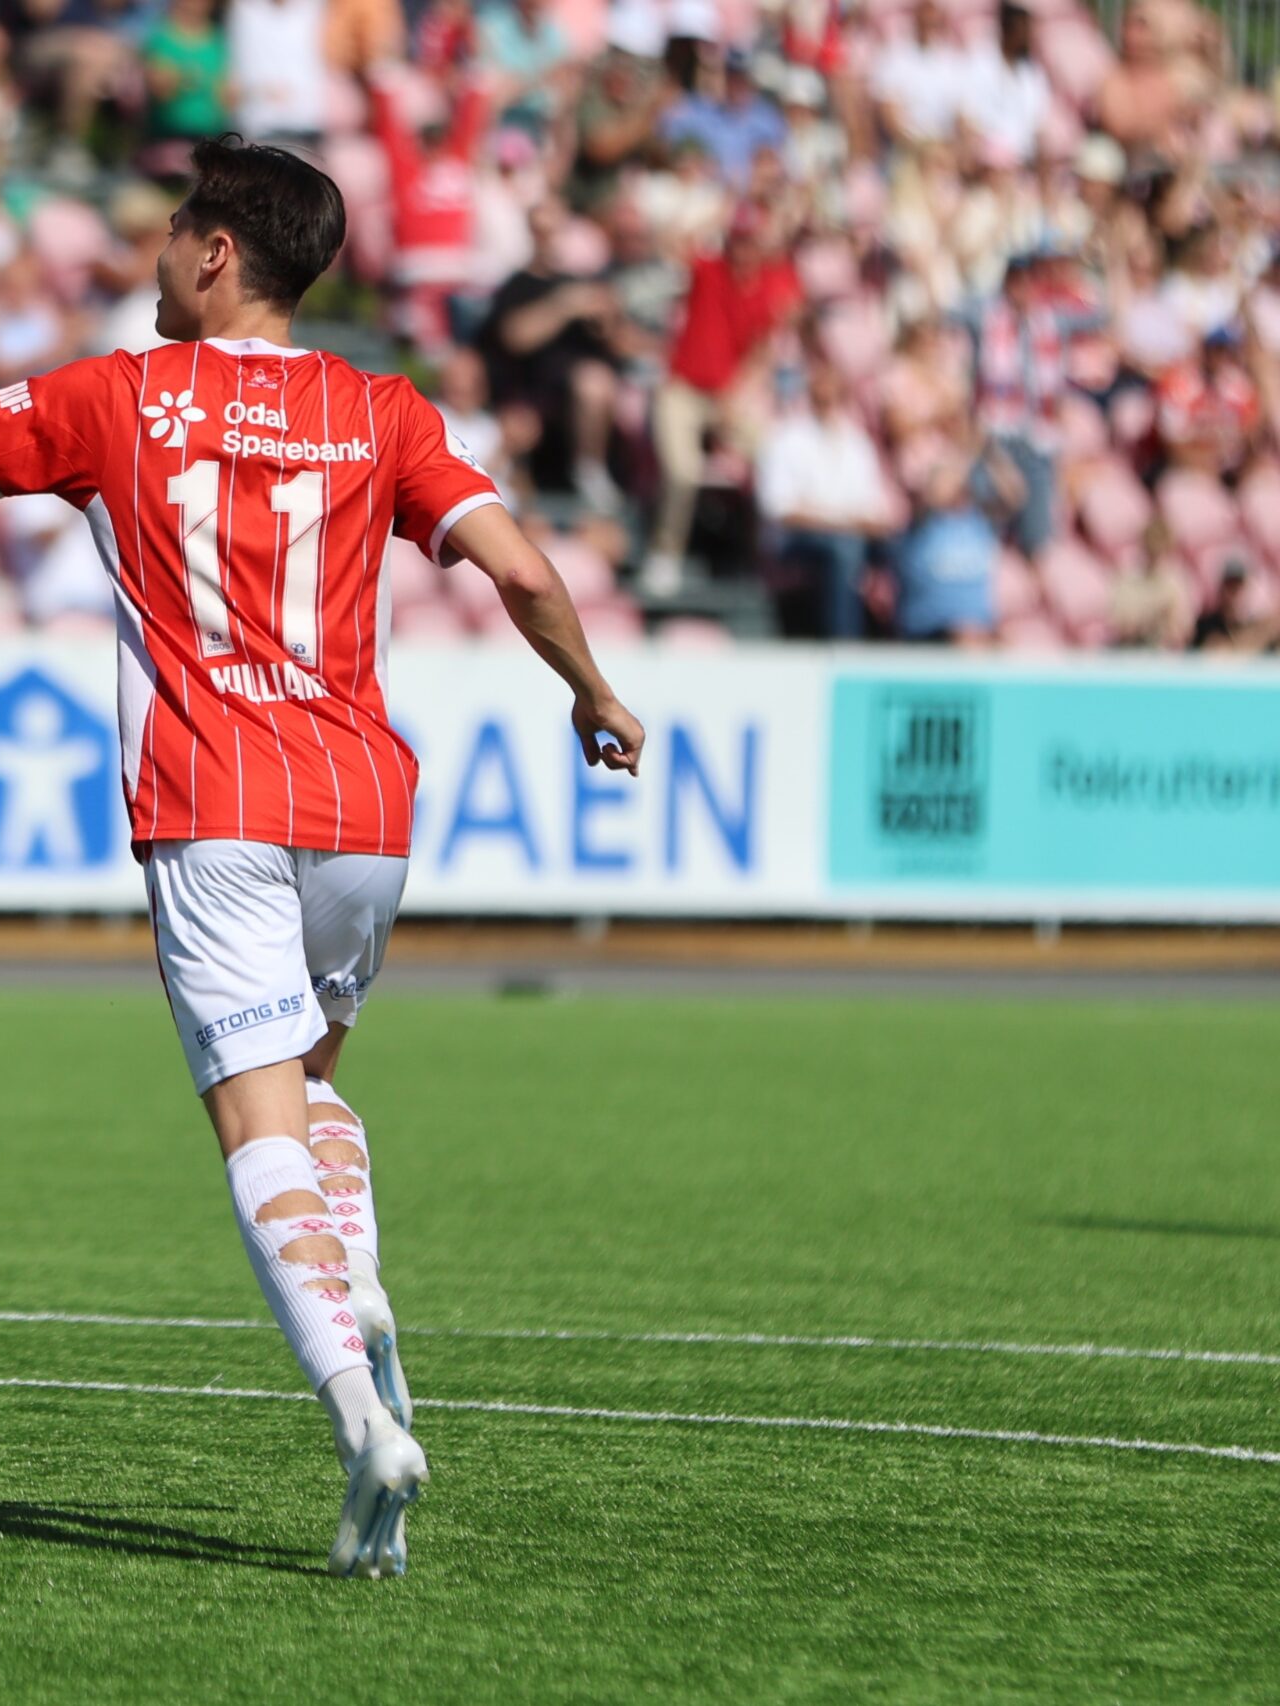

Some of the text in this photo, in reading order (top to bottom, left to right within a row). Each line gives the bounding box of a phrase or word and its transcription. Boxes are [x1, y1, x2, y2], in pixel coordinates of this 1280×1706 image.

[223, 400, 289, 431] Odal
[221, 430, 372, 462] Sparebank
[166, 459, 324, 669] 11
[206, 642, 231, 652] OBOS
[396, 714, 761, 876] AEN
[195, 1003, 273, 1046] BETONG
